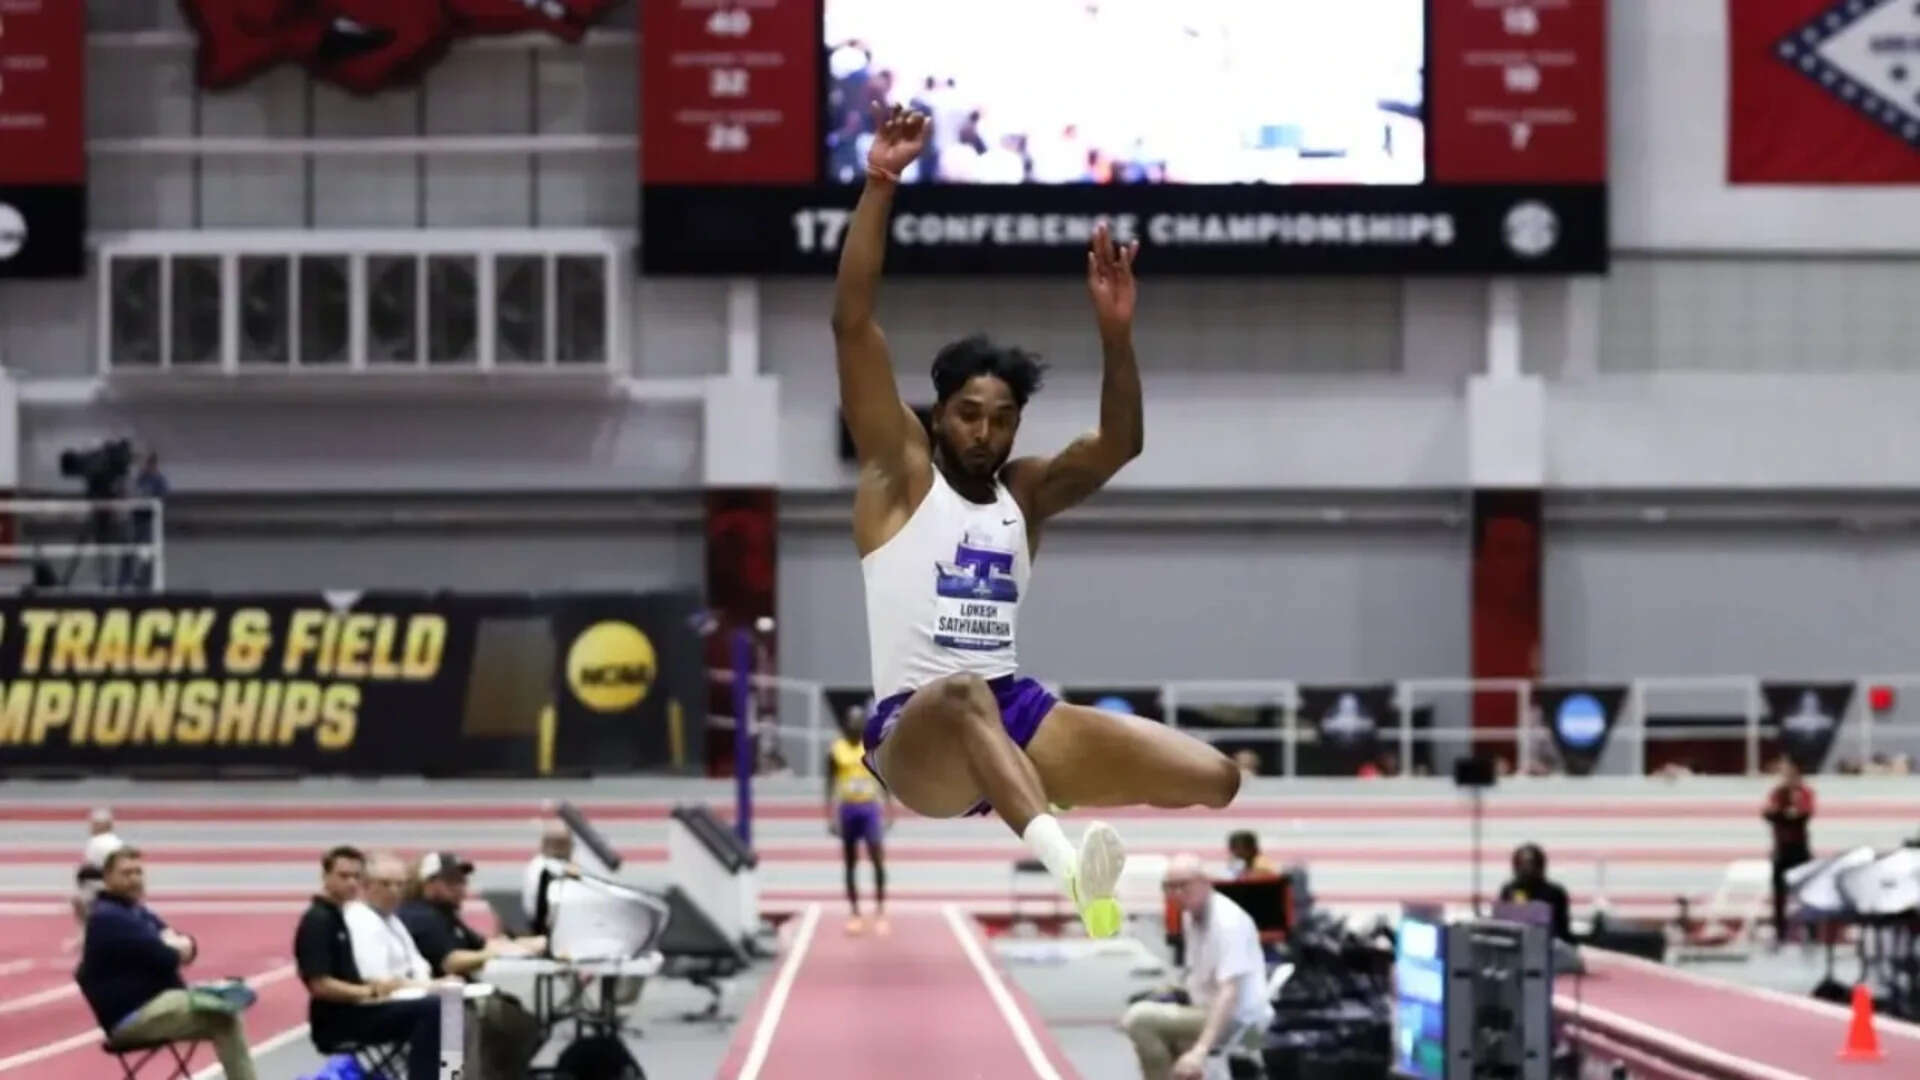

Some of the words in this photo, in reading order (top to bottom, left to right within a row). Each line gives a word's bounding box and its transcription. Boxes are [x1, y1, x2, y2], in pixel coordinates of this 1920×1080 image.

[794, 208, 856, 250] 17
[1148, 213, 1456, 245] CHAMPIONSHIPS
[938, 616, 1011, 636] SATHYANATHAN
[960, 603, 998, 618] LOKESH
[20, 608, 216, 674] TRACK
[223, 608, 272, 674] &
[281, 609, 447, 681] FIELD
